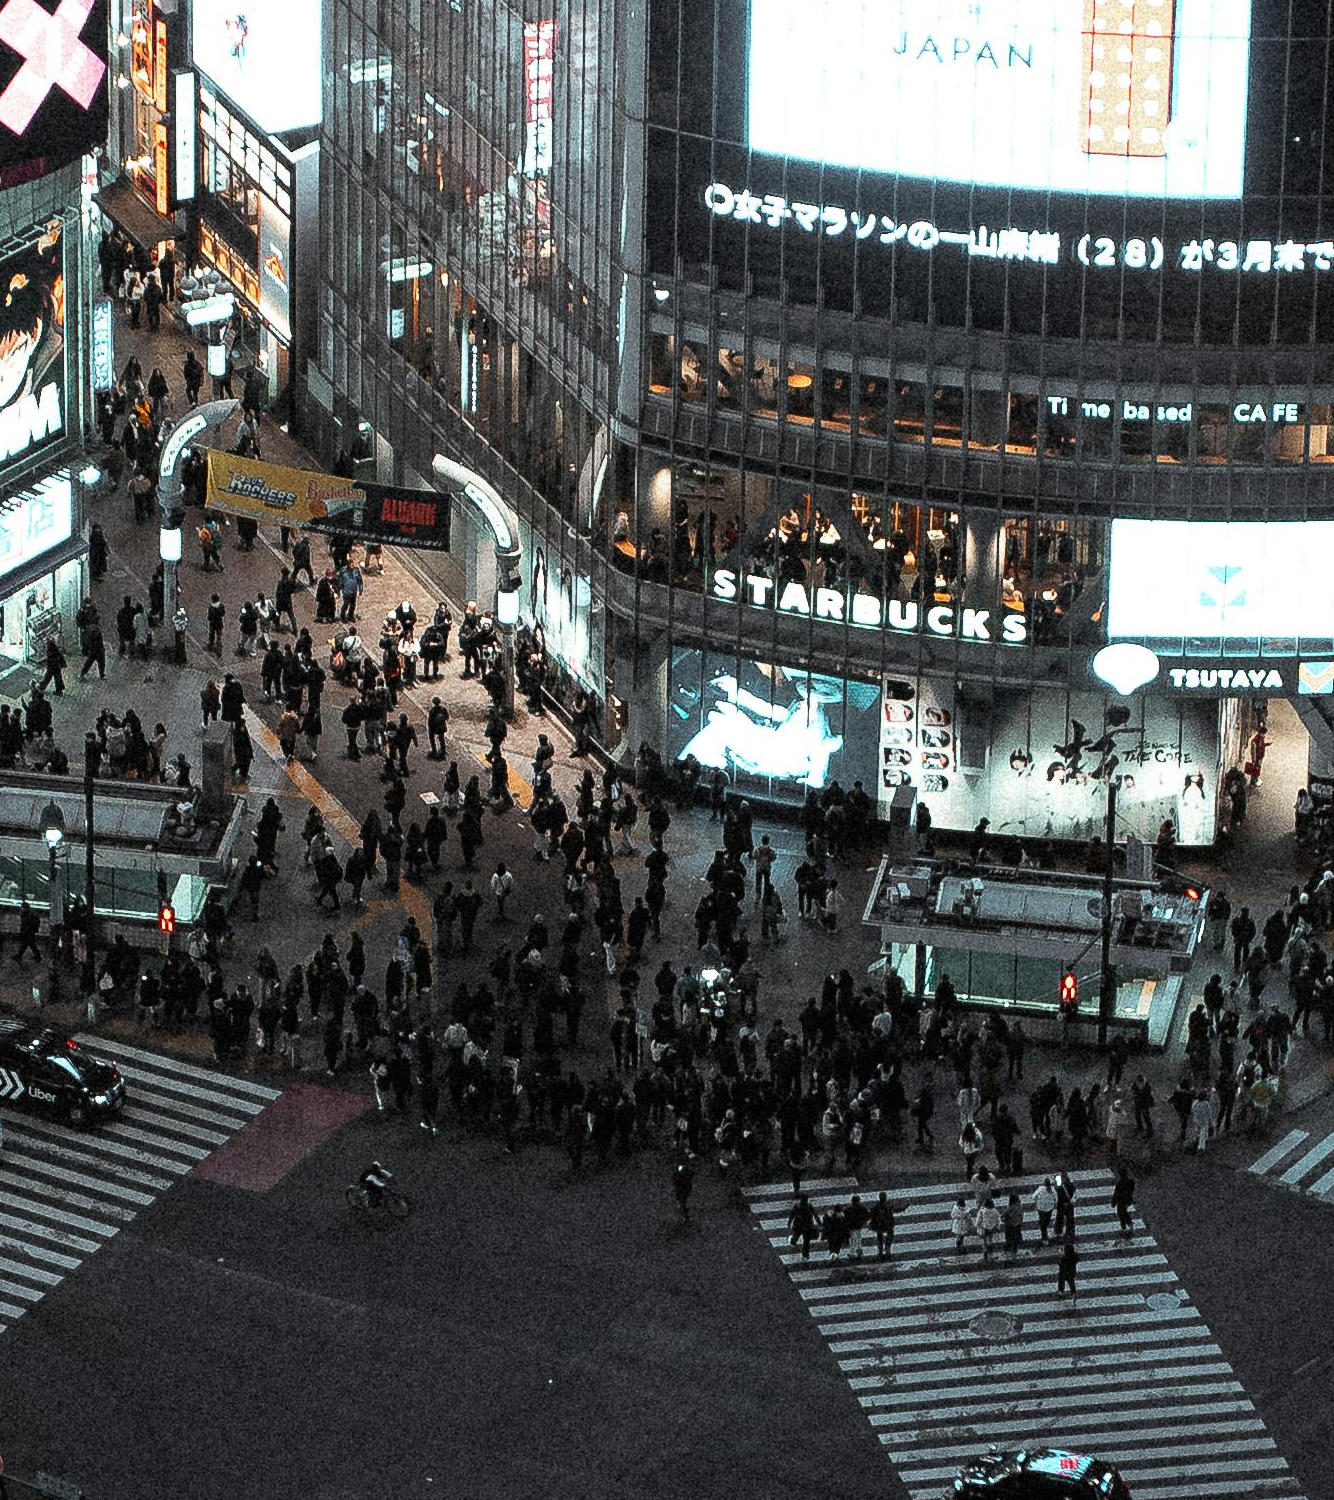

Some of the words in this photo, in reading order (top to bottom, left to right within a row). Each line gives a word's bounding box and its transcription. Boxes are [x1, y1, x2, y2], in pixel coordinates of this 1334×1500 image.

[893, 31, 1033, 69] JAPAN
[1234, 403, 1298, 423] CAFE
[714, 568, 1027, 643] STARBUCKS
[1169, 667, 1284, 690] TSUTAYA
[28, 1085, 57, 1103] Uber
